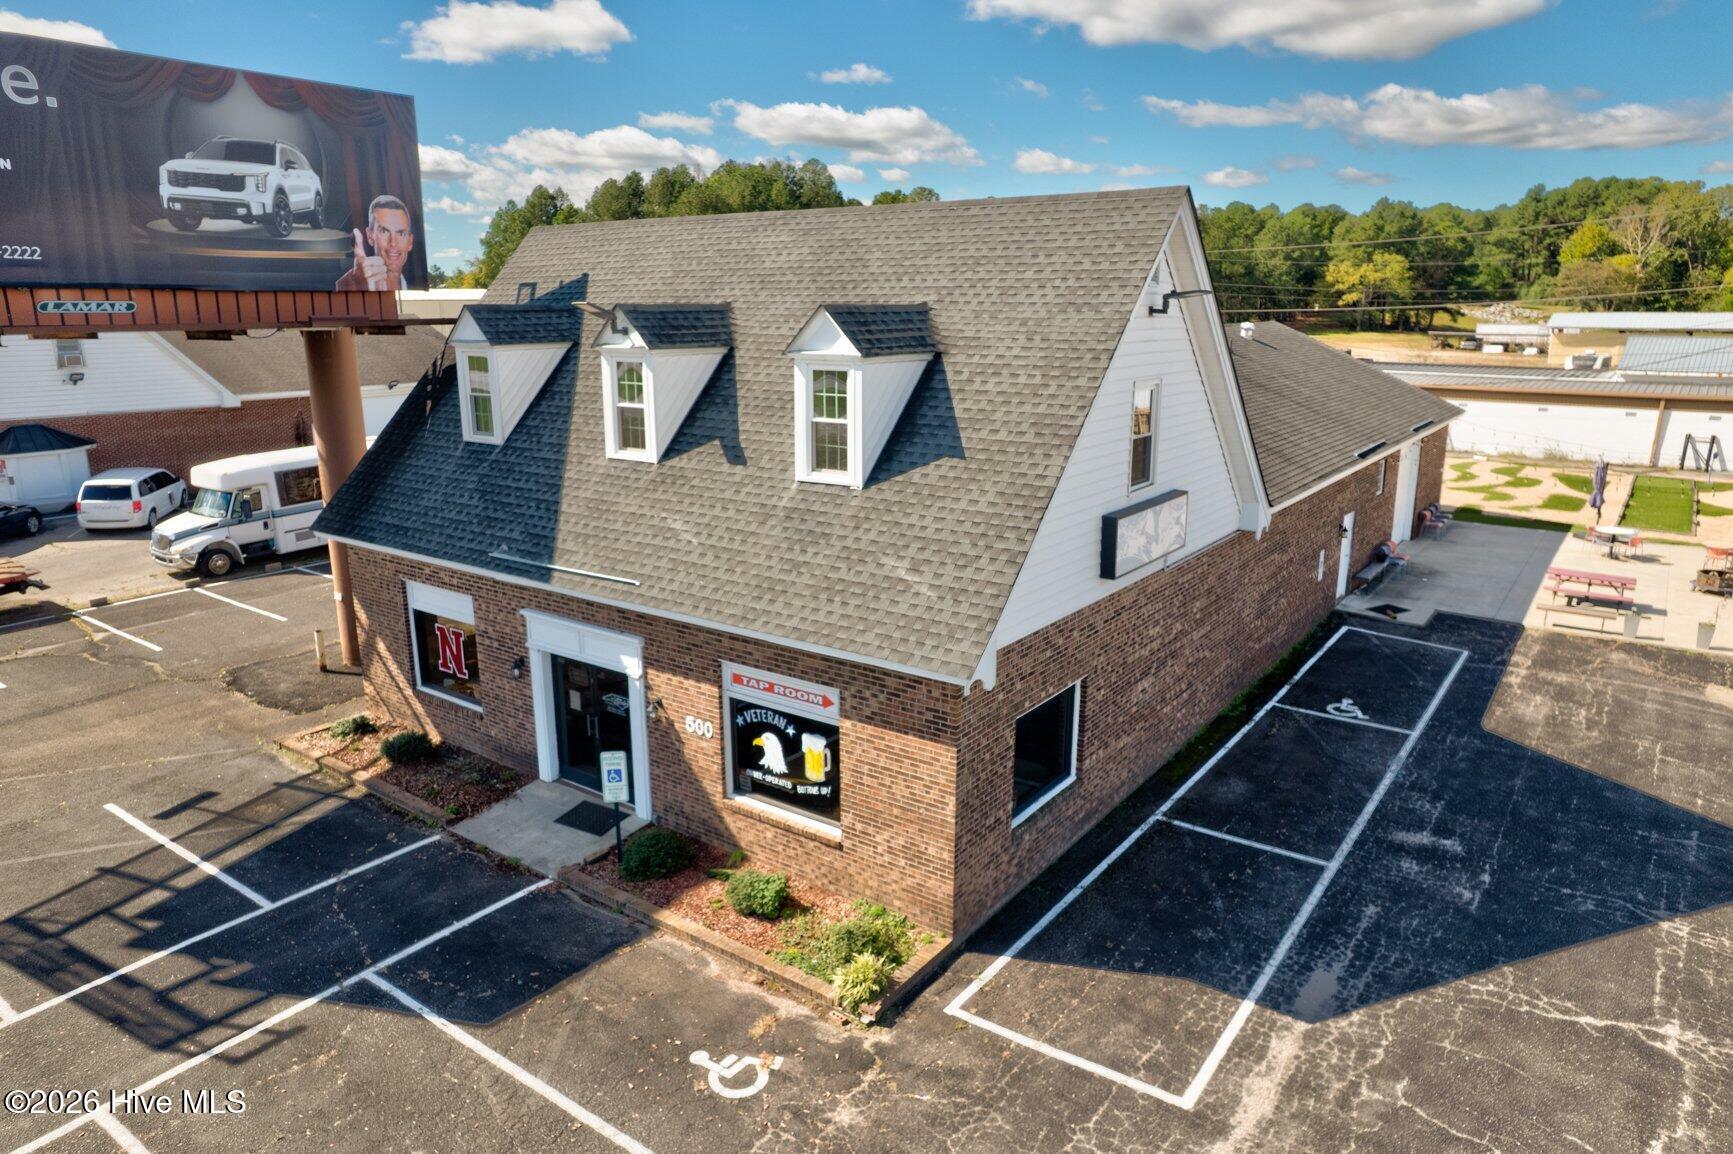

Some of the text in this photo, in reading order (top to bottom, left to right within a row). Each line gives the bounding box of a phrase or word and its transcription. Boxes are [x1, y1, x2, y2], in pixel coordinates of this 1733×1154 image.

[46, 302, 127, 312] LAMAR
[434, 623, 469, 680] N
[740, 676, 823, 705] TAP ROOM
[685, 715, 713, 739] 500
[743, 709, 787, 730] VETERAN
